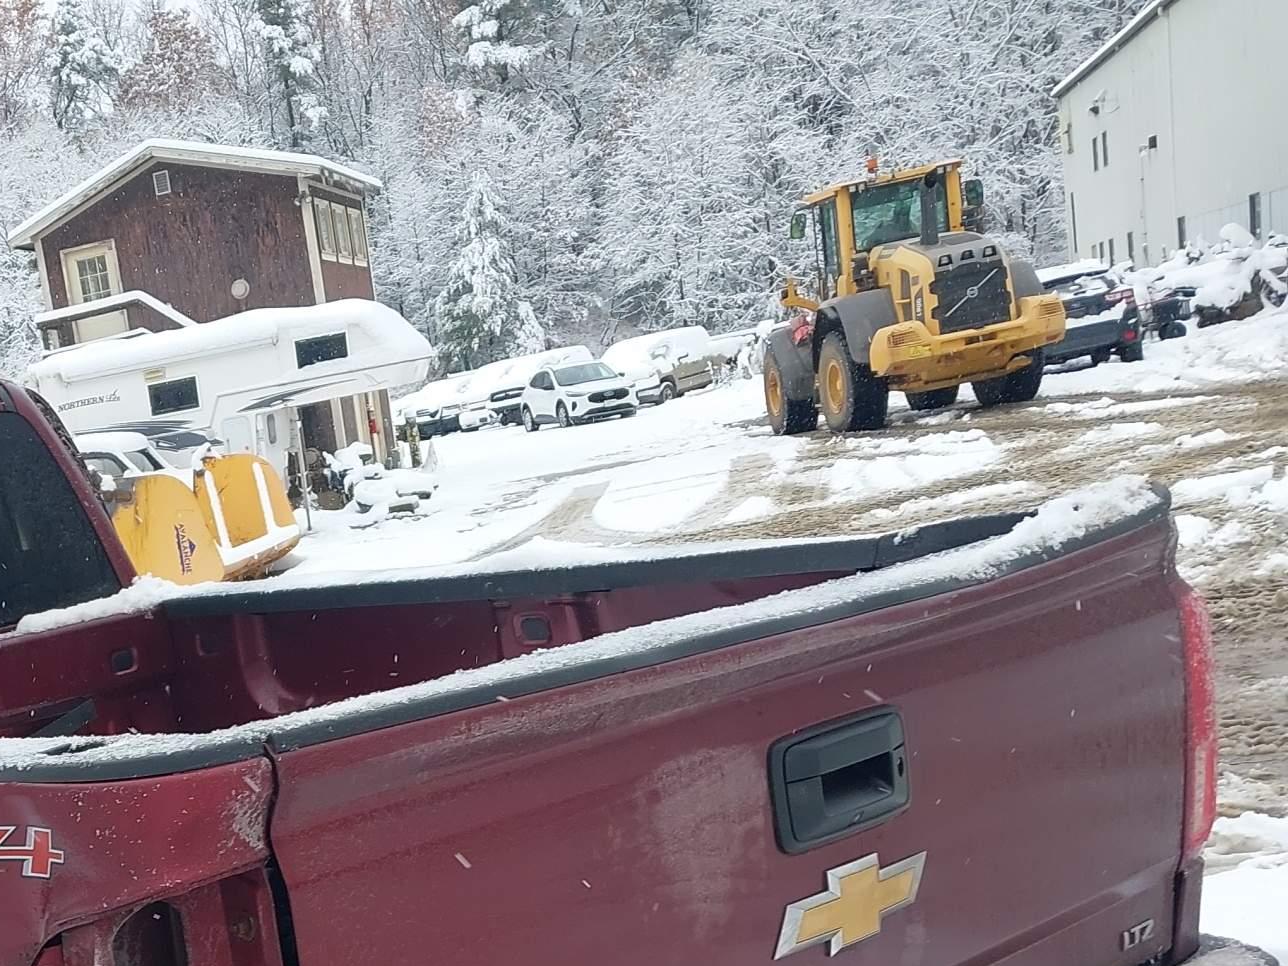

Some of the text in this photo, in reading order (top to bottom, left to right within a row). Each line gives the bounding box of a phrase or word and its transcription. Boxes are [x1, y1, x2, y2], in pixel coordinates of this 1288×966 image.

[57, 395, 105, 413] NORTHERN
[177, 523, 193, 575] AVALANCHE
[1123, 919, 1154, 950] LTZ
